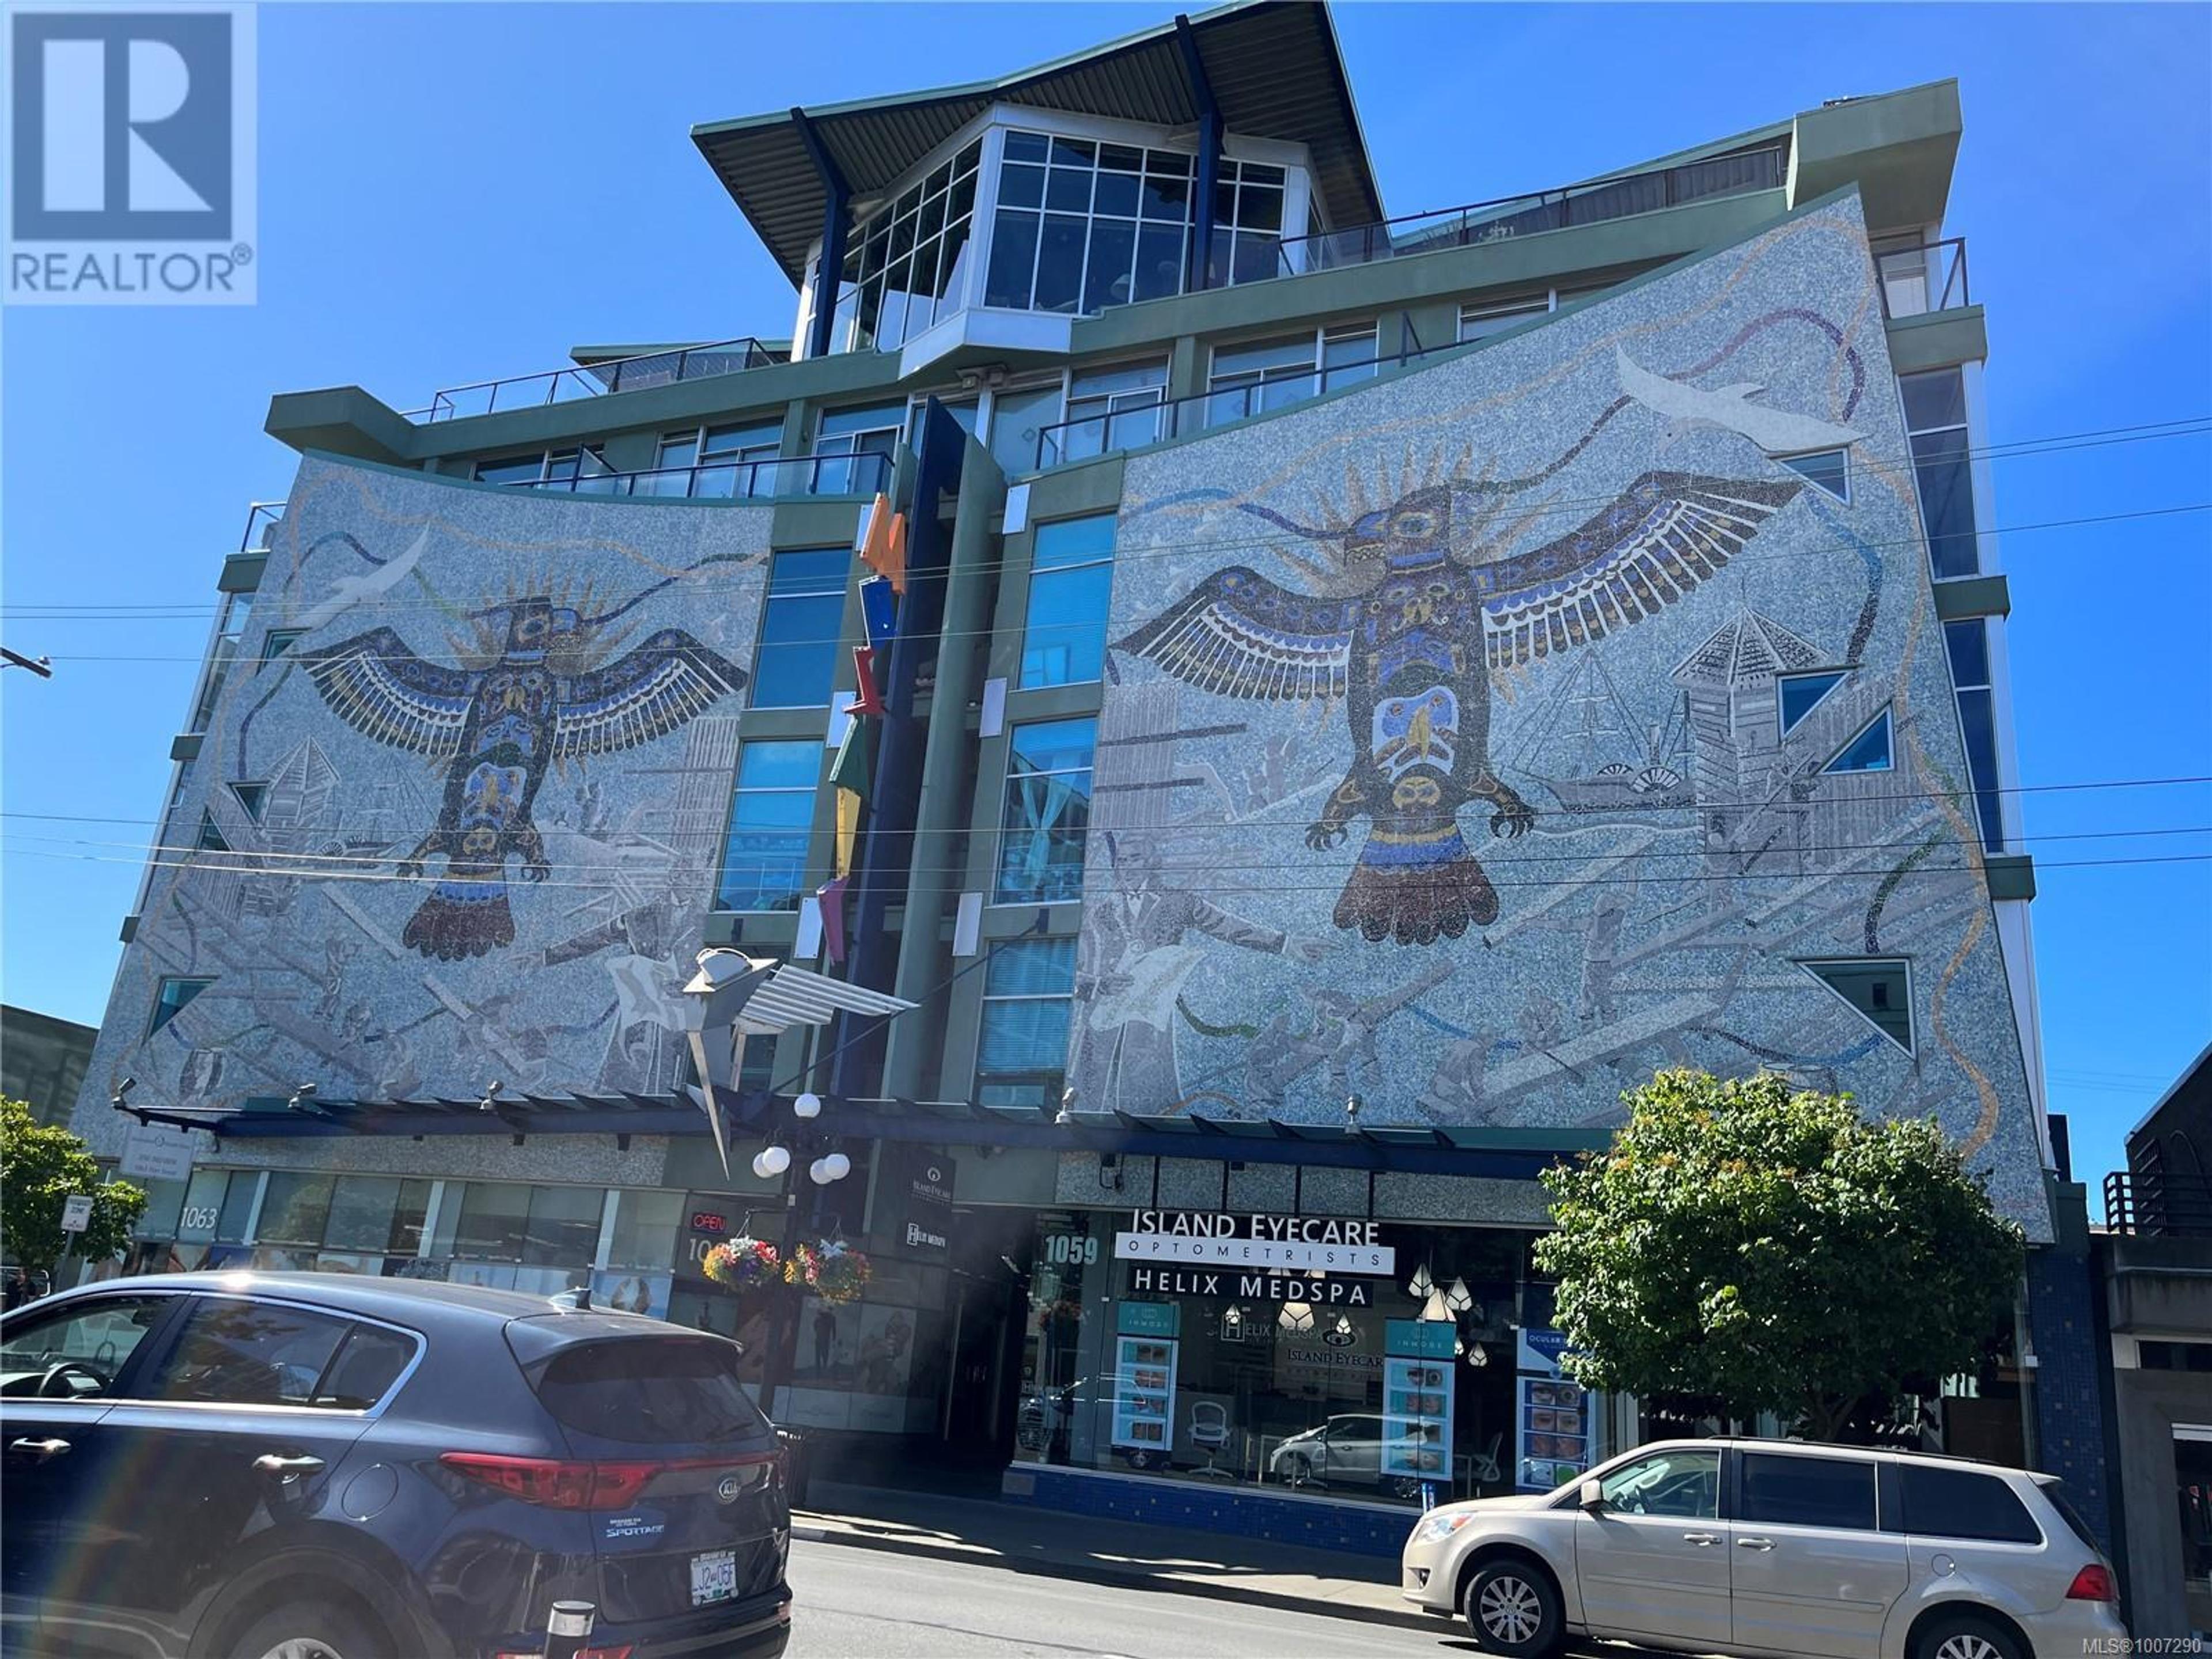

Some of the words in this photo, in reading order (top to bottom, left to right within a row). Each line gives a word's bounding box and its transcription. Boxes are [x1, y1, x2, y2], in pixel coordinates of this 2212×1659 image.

[181, 1207, 217, 1229] 1063
[694, 1215, 725, 1230] OPEN
[1132, 1208, 1236, 1238] ISLAND
[1251, 1214, 1380, 1246] EYECARE
[1046, 1236, 1098, 1264] 1059
[1129, 1240, 1380, 1266] OPTOMETRISTS
[1135, 1269, 1218, 1294] HELIX
[1241, 1276, 1365, 1305] MEDSPA
[1288, 1349, 1332, 1362] ISLAND
[1336, 1353, 1383, 1367] EYECAR
